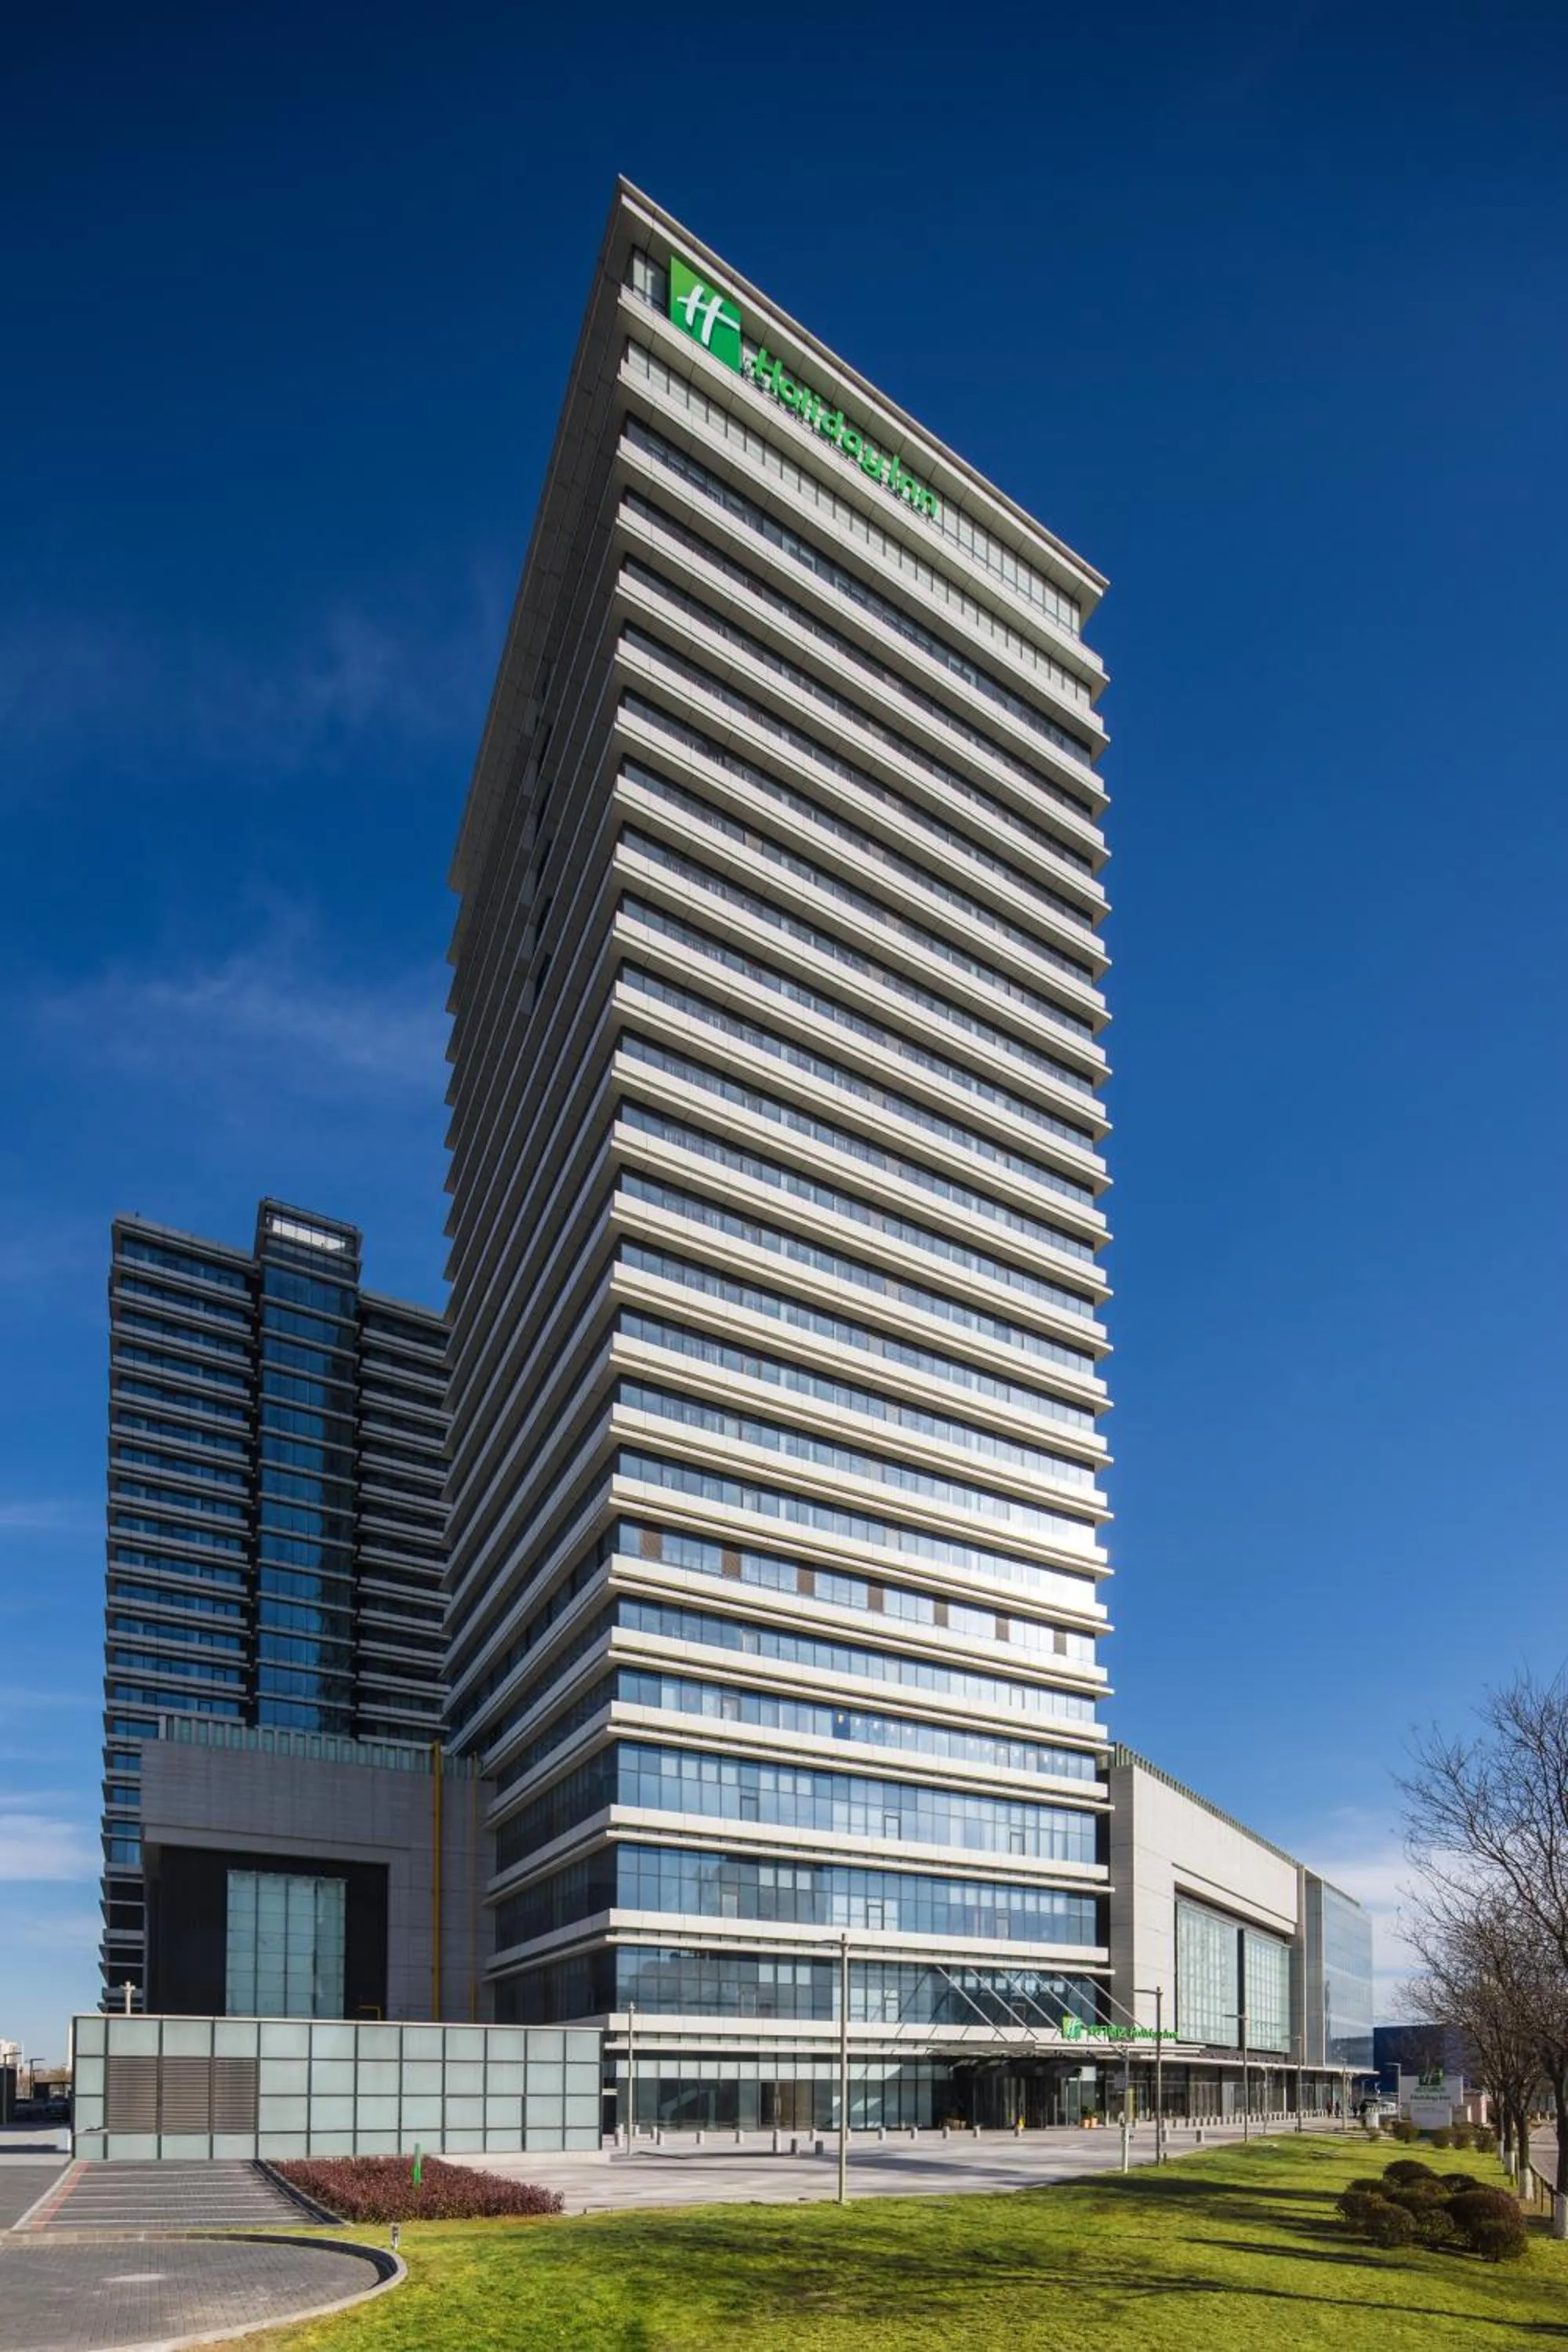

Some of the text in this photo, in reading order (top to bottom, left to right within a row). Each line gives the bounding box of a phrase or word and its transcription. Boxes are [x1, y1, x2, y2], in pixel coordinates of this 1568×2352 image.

[677, 284, 741, 346] H
[754, 349, 938, 519] Holiday Inn
